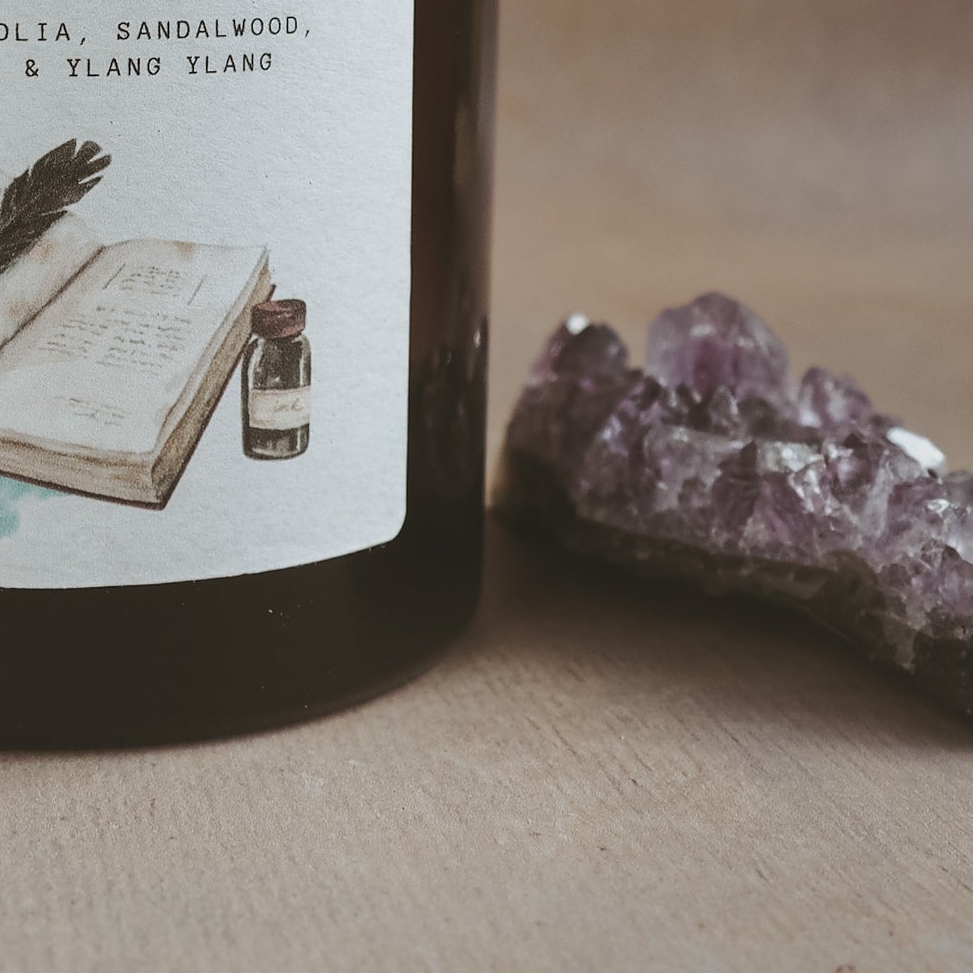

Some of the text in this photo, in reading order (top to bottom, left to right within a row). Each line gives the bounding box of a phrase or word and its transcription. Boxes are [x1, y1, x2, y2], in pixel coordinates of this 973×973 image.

[116, 15, 310, 41] SANDALWOOD,
[24, 58, 40, 78] &
[66, 56, 161, 78] YLANG
[186, 52, 272, 75] YLANG
